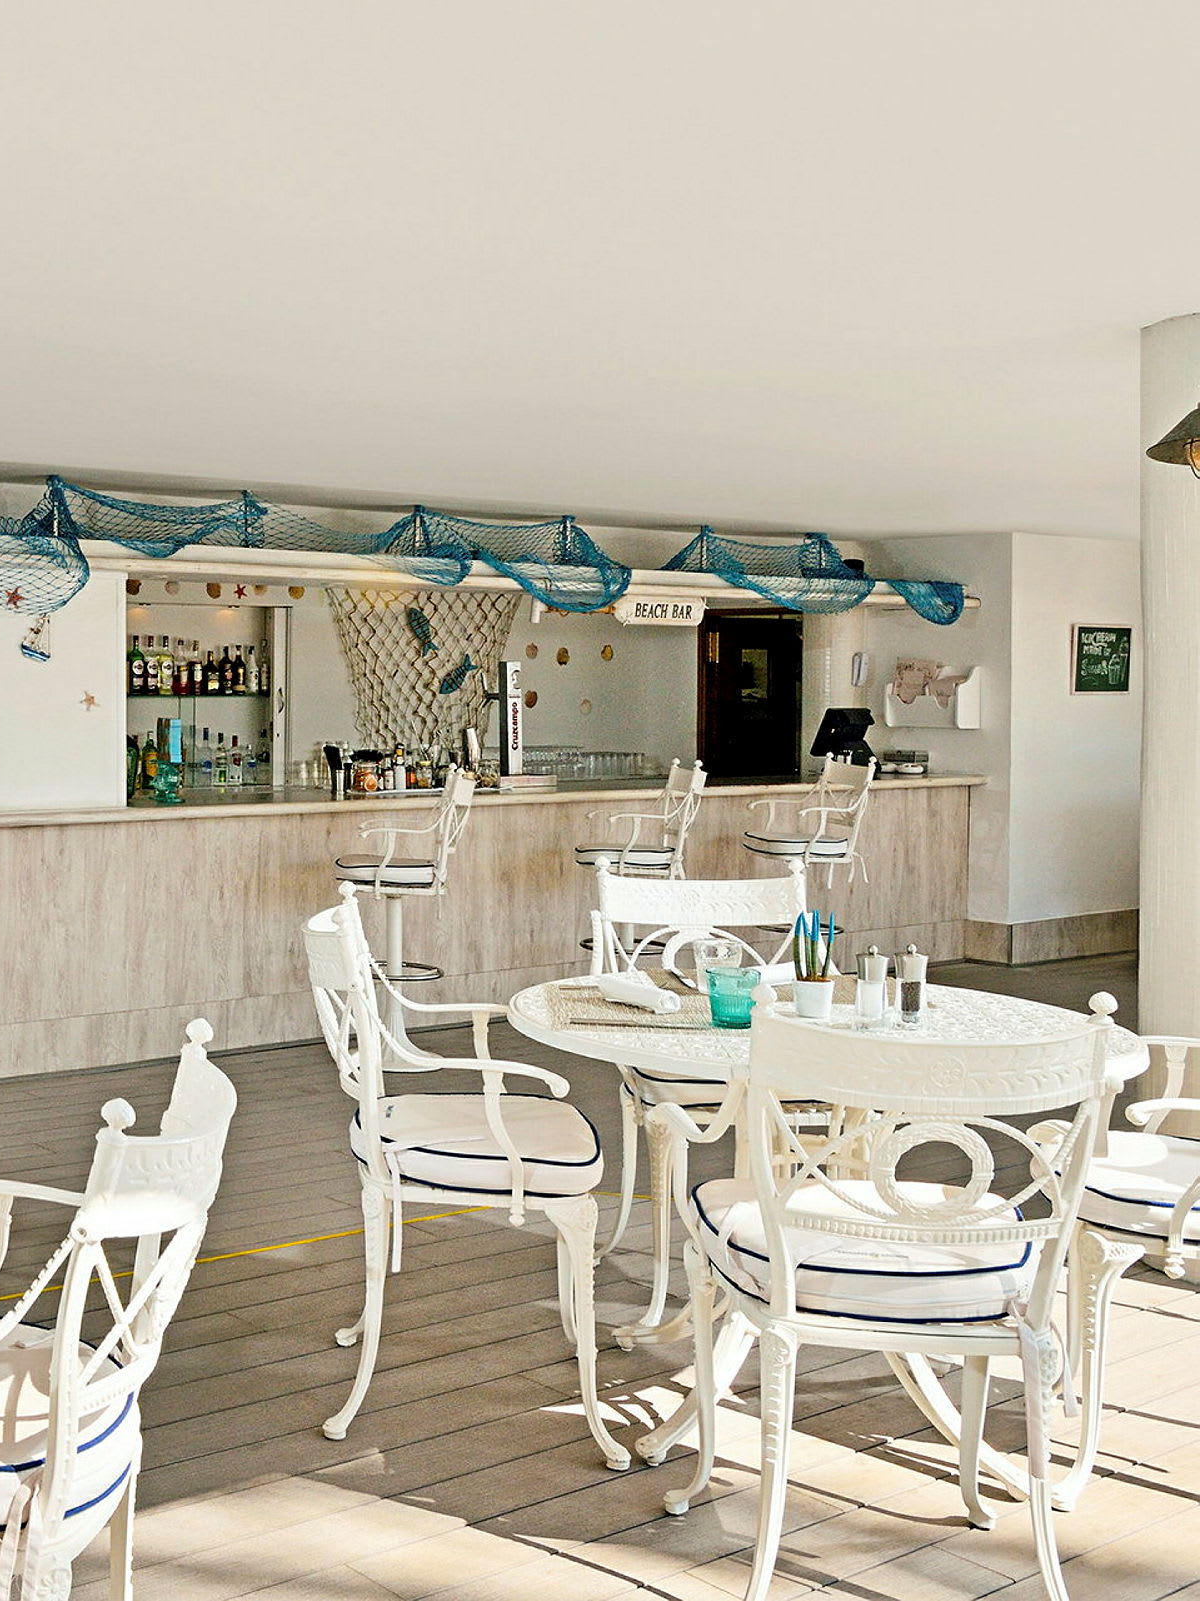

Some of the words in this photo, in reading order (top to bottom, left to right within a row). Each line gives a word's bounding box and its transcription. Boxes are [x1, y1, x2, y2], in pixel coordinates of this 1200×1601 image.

[634, 603, 669, 619] BEACH
[672, 604, 692, 619] BAR
[511, 701, 519, 751] Cruzcampo
